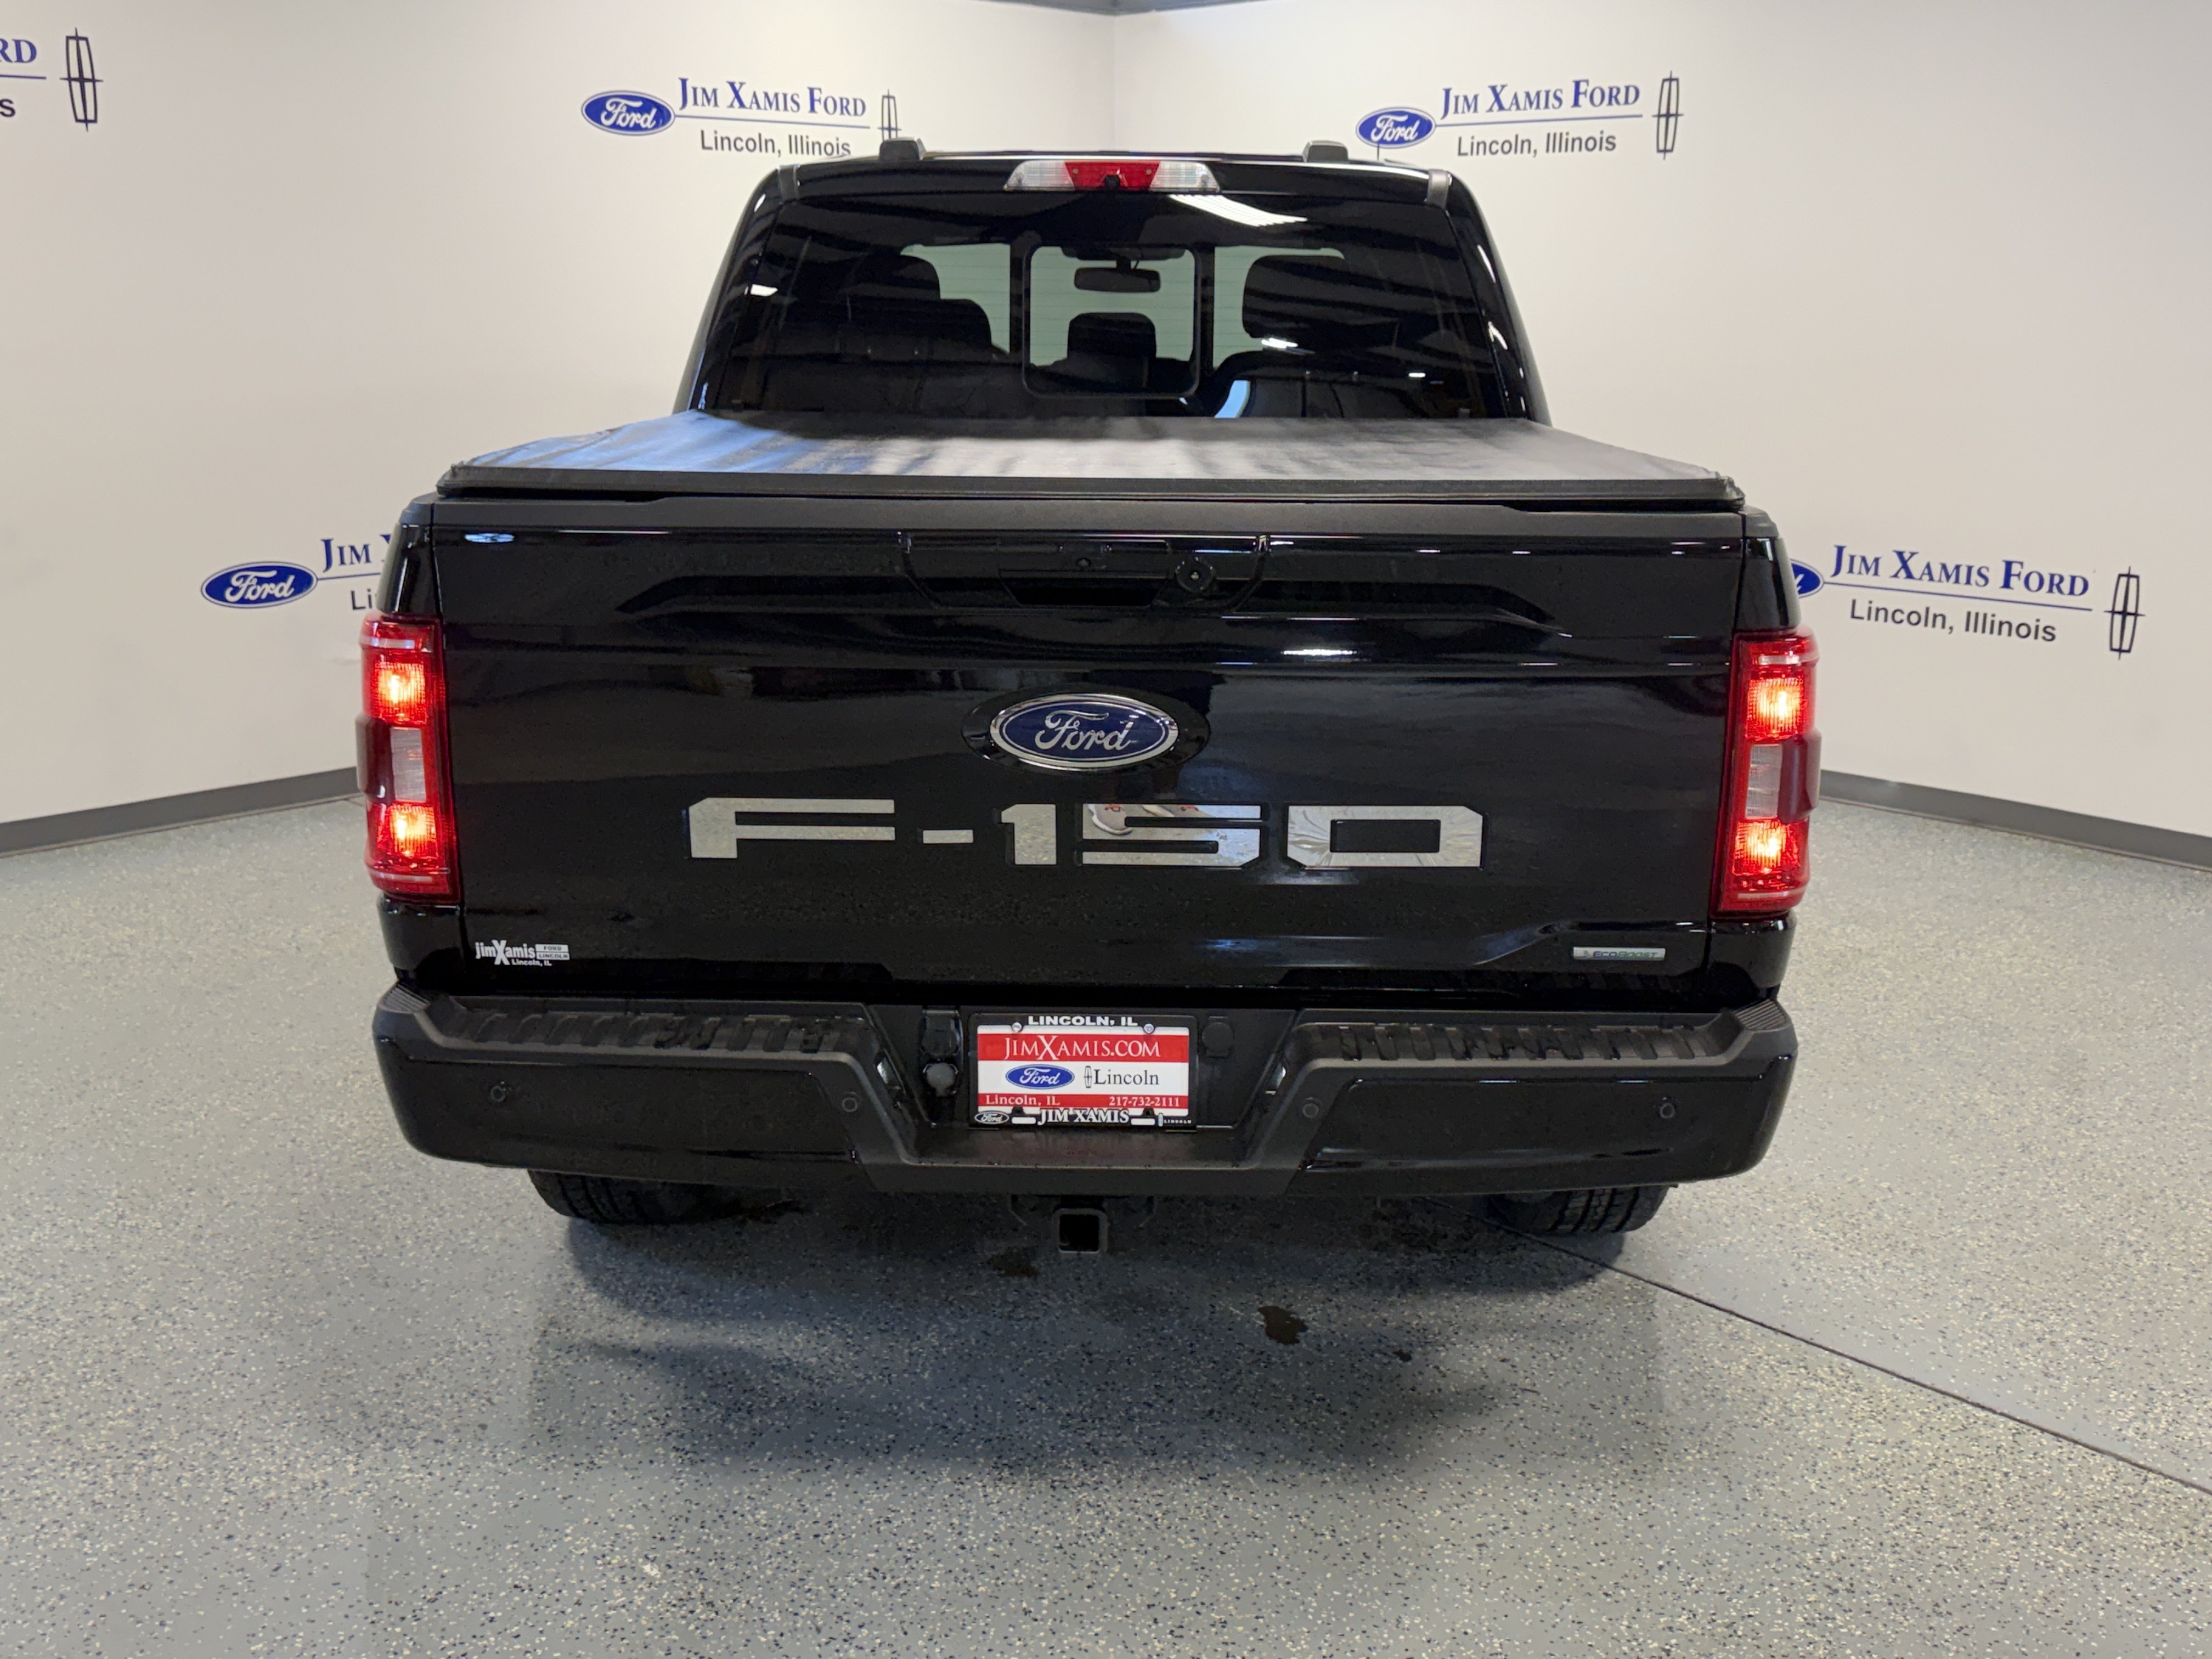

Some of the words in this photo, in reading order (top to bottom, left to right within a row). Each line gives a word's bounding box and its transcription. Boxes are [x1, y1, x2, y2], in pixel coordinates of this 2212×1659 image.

[679, 77, 719, 111] JIM
[726, 81, 800, 112] XAMIS
[807, 87, 866, 117] FORD
[1441, 87, 1480, 120] JIM
[1486, 84, 1563, 112] XAMIS
[1571, 79, 1640, 108] FORD
[600, 98, 657, 129] Ford
[1370, 114, 1420, 142] Ford
[701, 129, 781, 157] Lincoln,
[788, 134, 851, 156] Illinois
[1457, 136, 1538, 158] Lincoln,
[1545, 130, 1617, 154] Illinois
[321, 538, 372, 573] JIM
[1830, 545, 1883, 578] JIM
[1890, 550, 1989, 588] XAMIS
[1999, 560, 2090, 597] FORD
[225, 570, 295, 602] Ford
[1849, 599, 1954, 635] Lincoln,
[1965, 611, 2057, 642] Illinois
[1035, 709, 1136, 751] Ford
[689, 797, 1483, 867] F-150
[1028, 1015, 1115, 1026] LINCOLN,
[1121, 1017, 1138, 1026] IL
[1004, 1035, 1161, 1061] JIMXAMIS.COM
[1019, 1067, 1060, 1085] Ford
[1093, 1069, 1159, 1085] Lincoln
[986, 1095, 1041, 1106] Lincoln,
[1046, 1096, 1060, 1106] IL
[1108, 1096, 1180, 1107] 217-732-2111
[980, 1114, 1003, 1122] Ford
[1037, 1108, 1069, 1125] JIM
[1073, 1108, 1130, 1124] XAMIS
